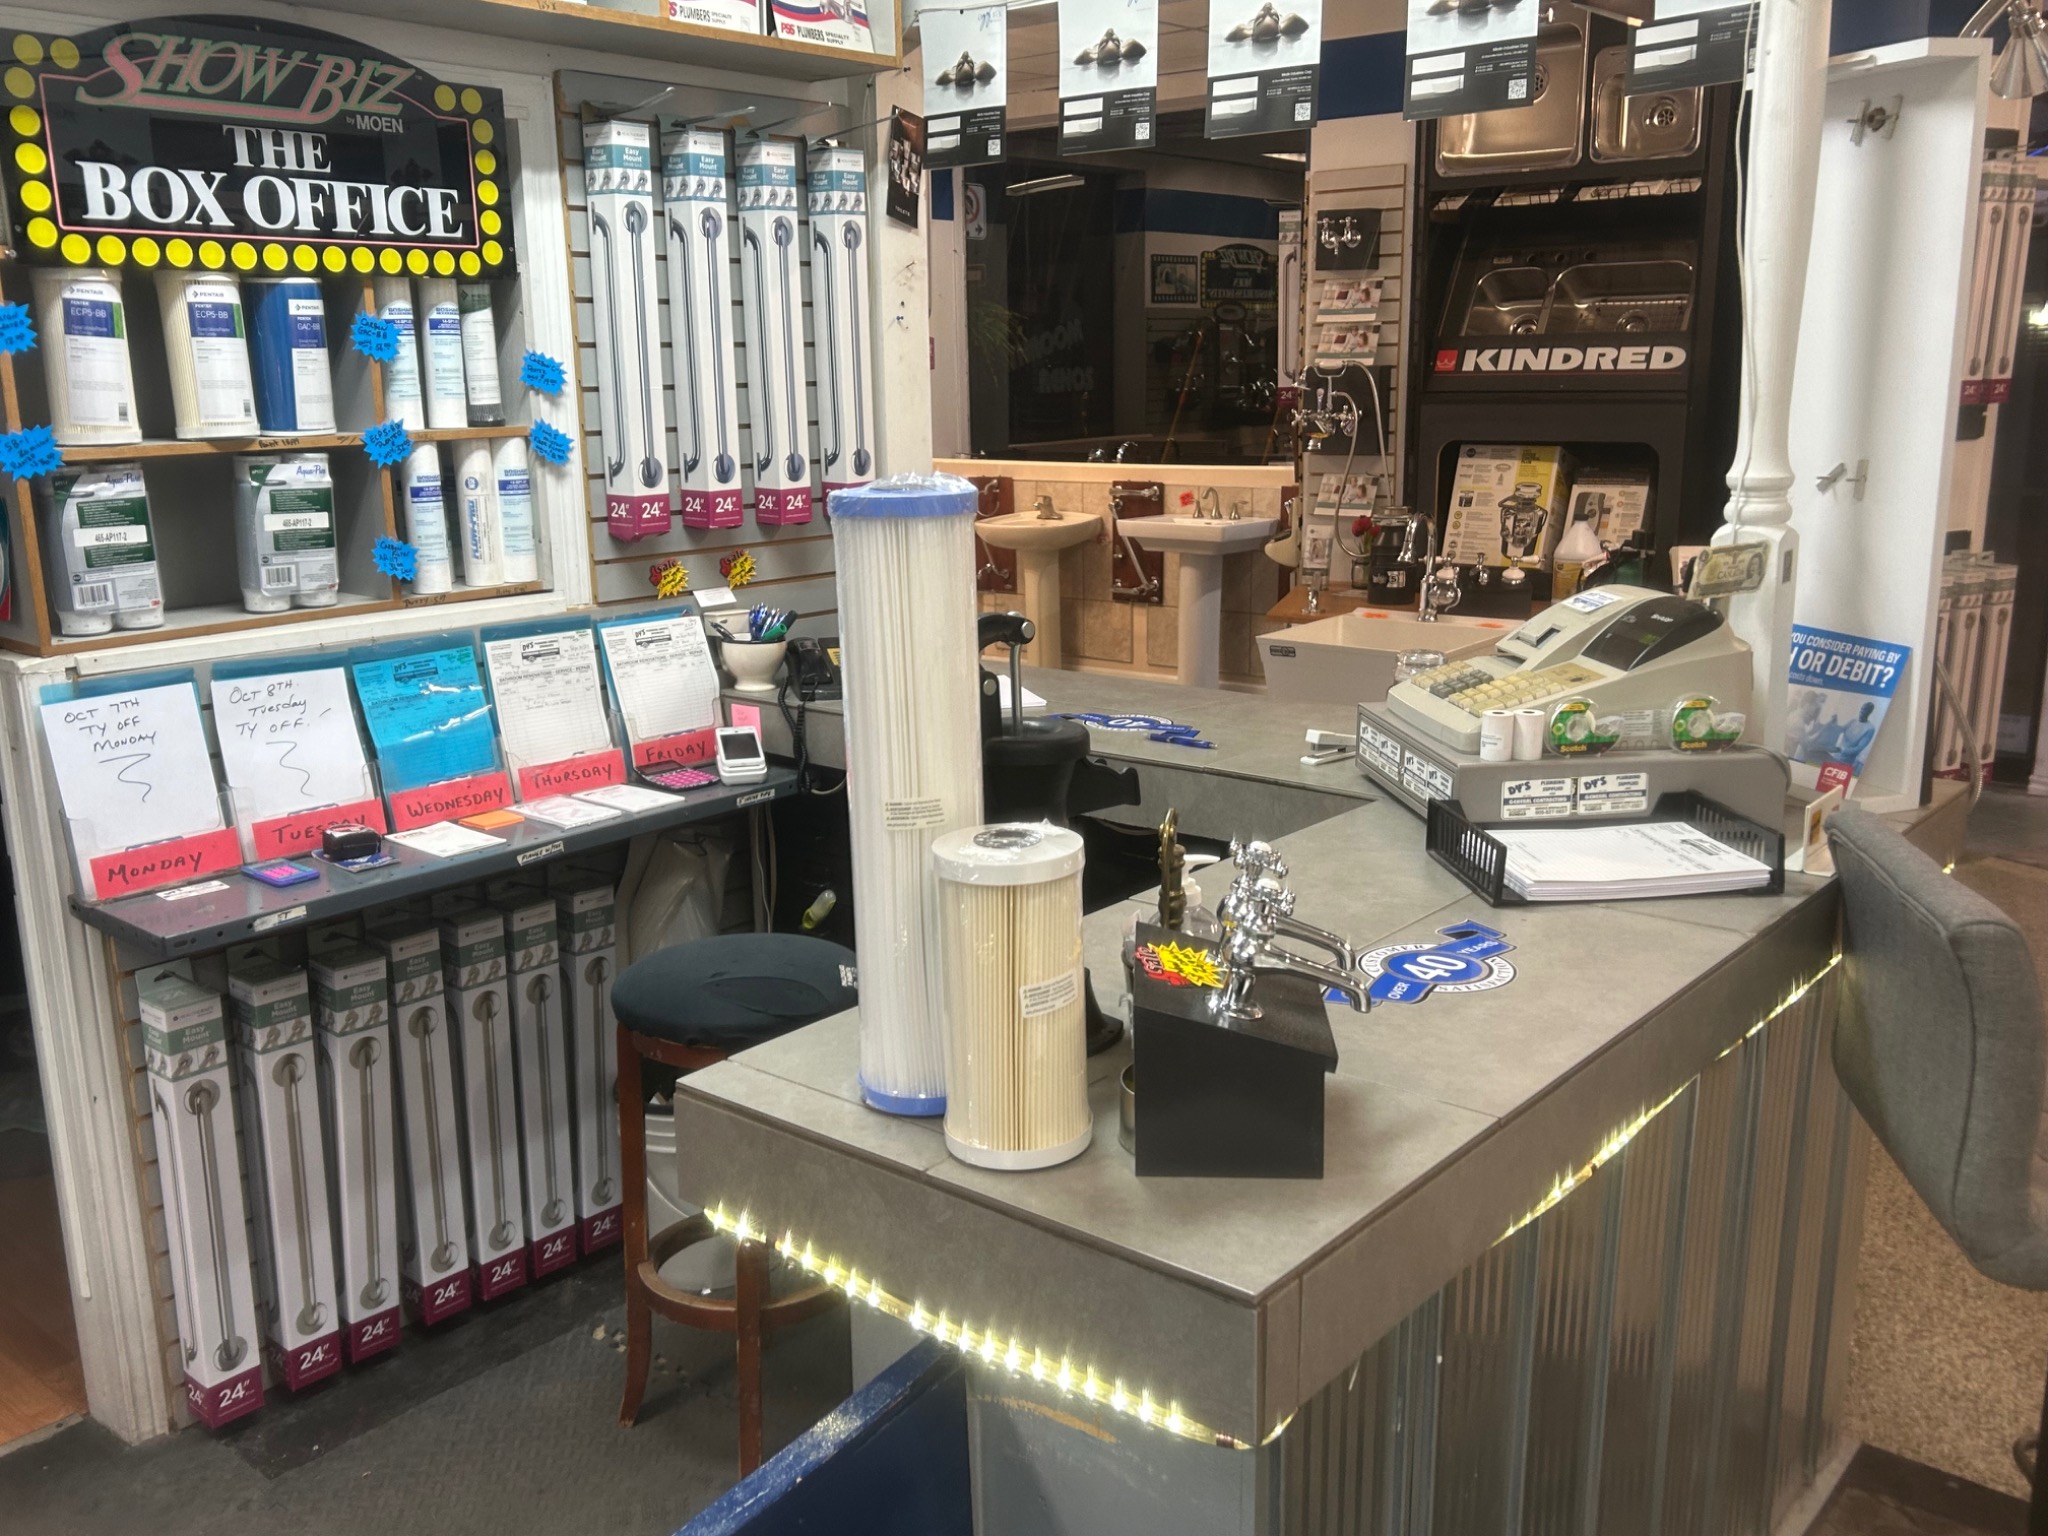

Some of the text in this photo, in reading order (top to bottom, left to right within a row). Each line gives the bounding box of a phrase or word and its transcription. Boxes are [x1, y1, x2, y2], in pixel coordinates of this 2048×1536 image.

[679, 5, 711, 23] PLUMBERS
[781, 22, 796, 36] PSS
[797, 25, 825, 42] PLUMBERS
[75, 33, 415, 124] SHOW BIZ
[356, 114, 403, 134] MOEN
[222, 124, 332, 173] THE
[625, 147, 640, 156] Easy
[623, 154, 642, 162] Mount
[701, 156, 715, 164] Easy
[699, 162, 718, 170] Mount
[773, 167, 787, 176] Easy
[771, 173, 789, 181] Mount
[841, 178, 859, 186] Mount
[843, 173, 856, 181] Easy
[75, 160, 463, 238] BOX OFFICE
[70, 307, 107, 318] ECP5-BB
[195, 310, 229, 319] ECP5-BB
[1461, 346, 1688, 373] KINDRED
[1806, 635, 1853, 655] CONSIDER
[1852, 644, 1887, 661] PAYING
[1886, 652, 1902, 664] BY
[1798, 649, 1895, 688] OR DEBIT?
[229, 686, 260, 705] OCT
[64, 698, 140, 725] OCT 7TH
[117, 716, 141, 731] OFF
[93, 730, 158, 754] MONDAY
[1560, 744, 1587, 752] Scotch
[1681, 741, 1707, 749] Scotch
[645, 740, 706, 764] FRIDAY
[532, 764, 615, 790] THURSDAY
[1824, 767, 1849, 781] CFIB
[1507, 781, 1531, 795] DY'S
[1583, 776, 1607, 790] DY'S
[407, 789, 504, 818] WEDNESDAY
[1532, 796, 1567, 804] CONTRACTING
[108, 851, 203, 885] MONDAY
[1456, 941, 1499, 954] YEARS
[1366, 944, 1424, 974] CUSTOMER
[1402, 955, 1468, 980] 40
[350, 991, 374, 1001] Mount
[353, 985, 371, 995] Easy
[1387, 981, 1411, 999] OVER
[271, 1005, 297, 1017] Mount
[273, 1000, 293, 1010] Easy
[182, 1031, 210, 1044] Mount
[185, 1026, 205, 1036] Easy
